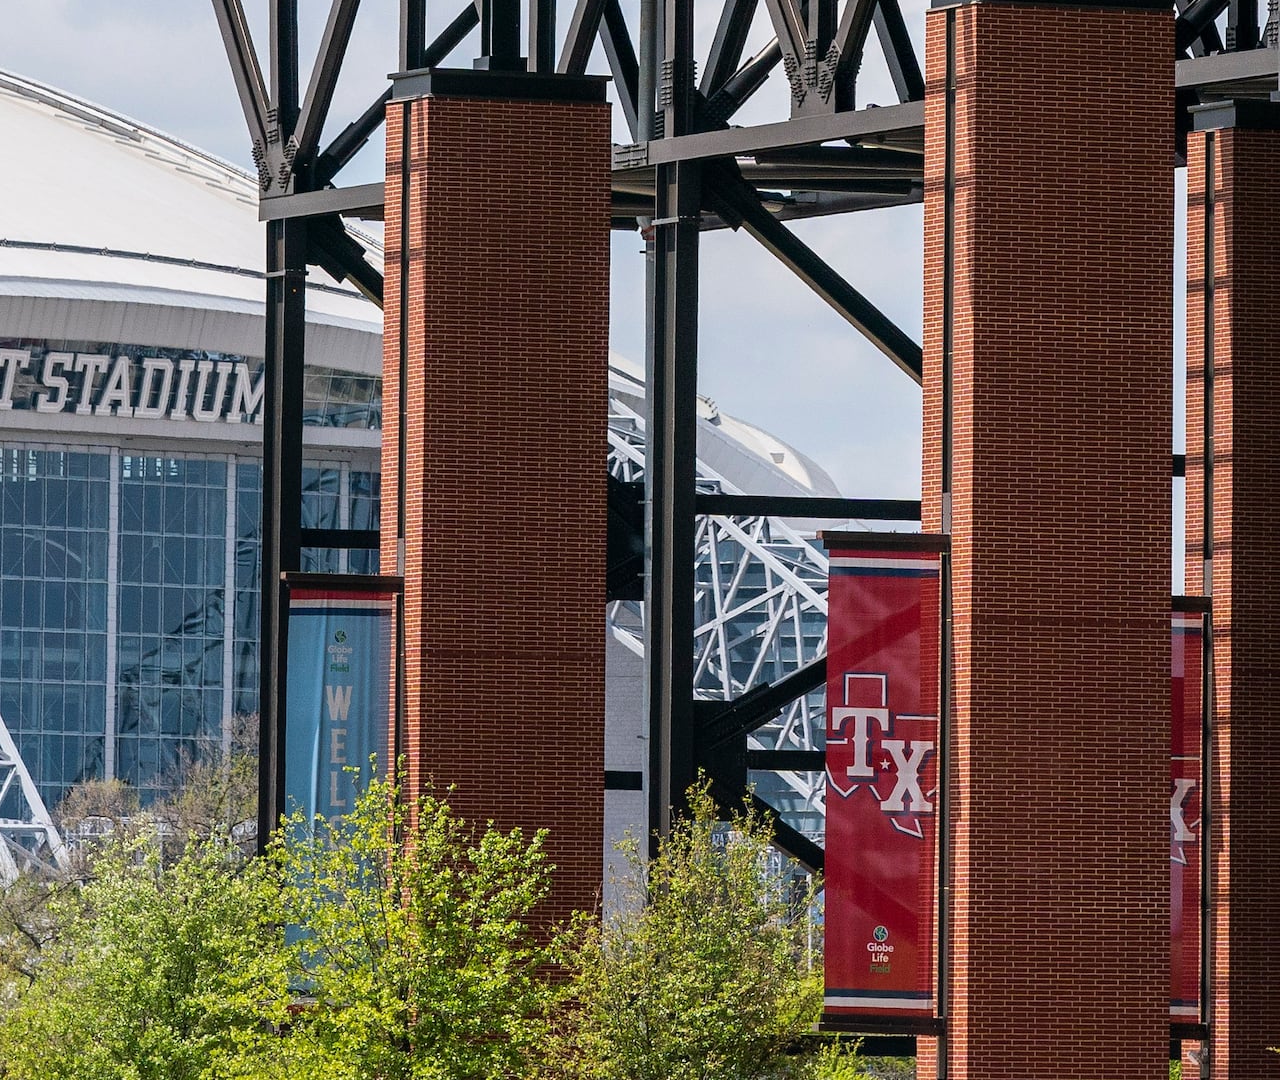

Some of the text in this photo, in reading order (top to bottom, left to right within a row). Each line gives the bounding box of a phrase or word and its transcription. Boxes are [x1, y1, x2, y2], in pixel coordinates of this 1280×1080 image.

[36, 351, 266, 425] STADIUM
[866, 942, 895, 953] Globe
[871, 953, 889, 963] Life
